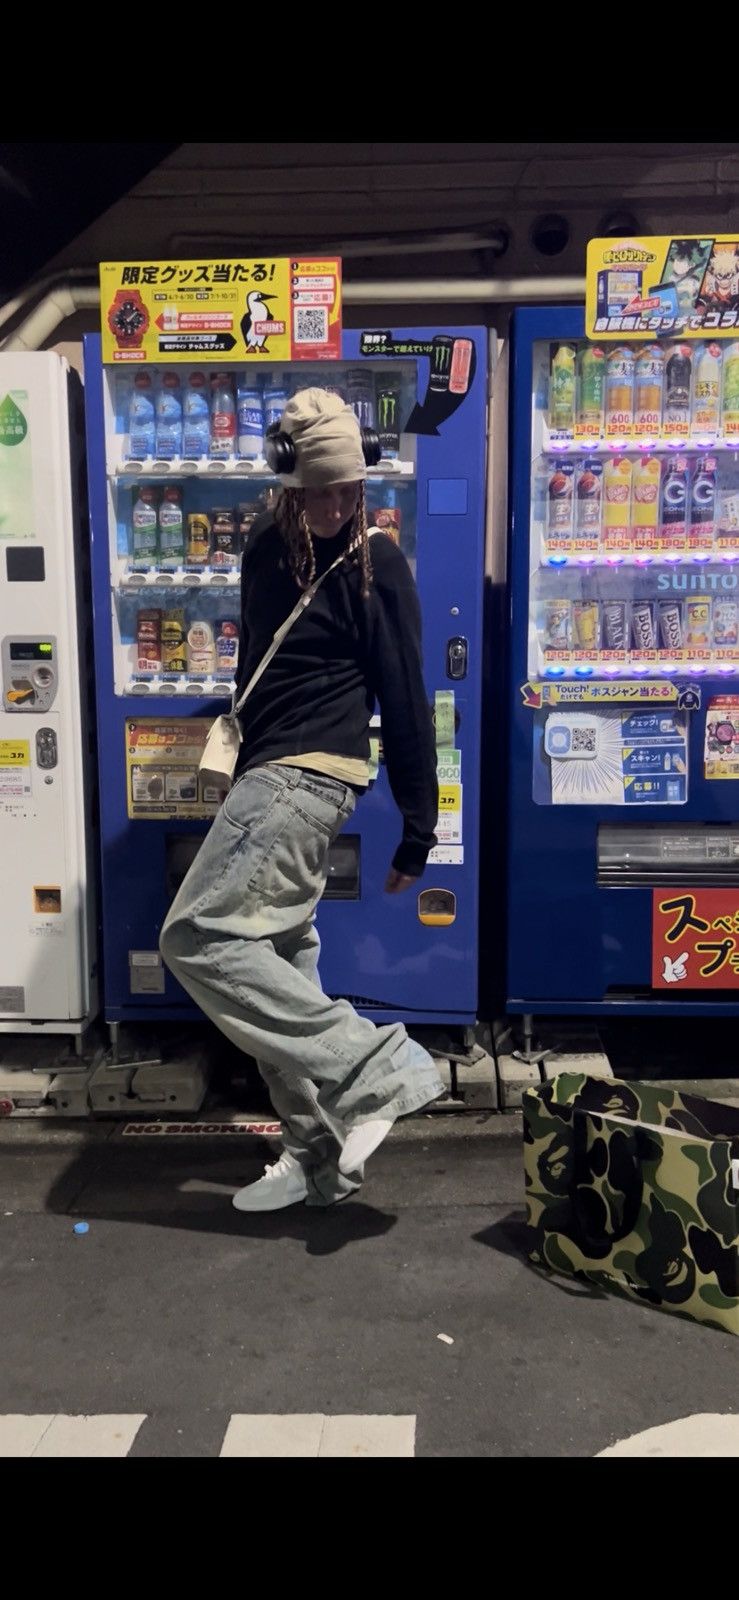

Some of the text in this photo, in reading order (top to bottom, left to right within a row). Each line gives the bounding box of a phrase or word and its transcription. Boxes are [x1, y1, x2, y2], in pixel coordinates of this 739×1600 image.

[121, 263, 276, 285] 限定グッズ当たる!
[594, 311, 739, 332] 自販機にタッチでコラ
[255, 322, 285, 334] CHUMS
[361, 345, 433, 353] モンスターで超えていけ
[638, 612, 651, 648] BOSS
[667, 612, 680, 647] BOSS
[555, 684, 589, 693] Touch!
[591, 686, 674, 697] ボスジャン当たる!
[631, 754, 661, 762] スキャン!
[124, 1124, 281, 1134] NO SMOKING
